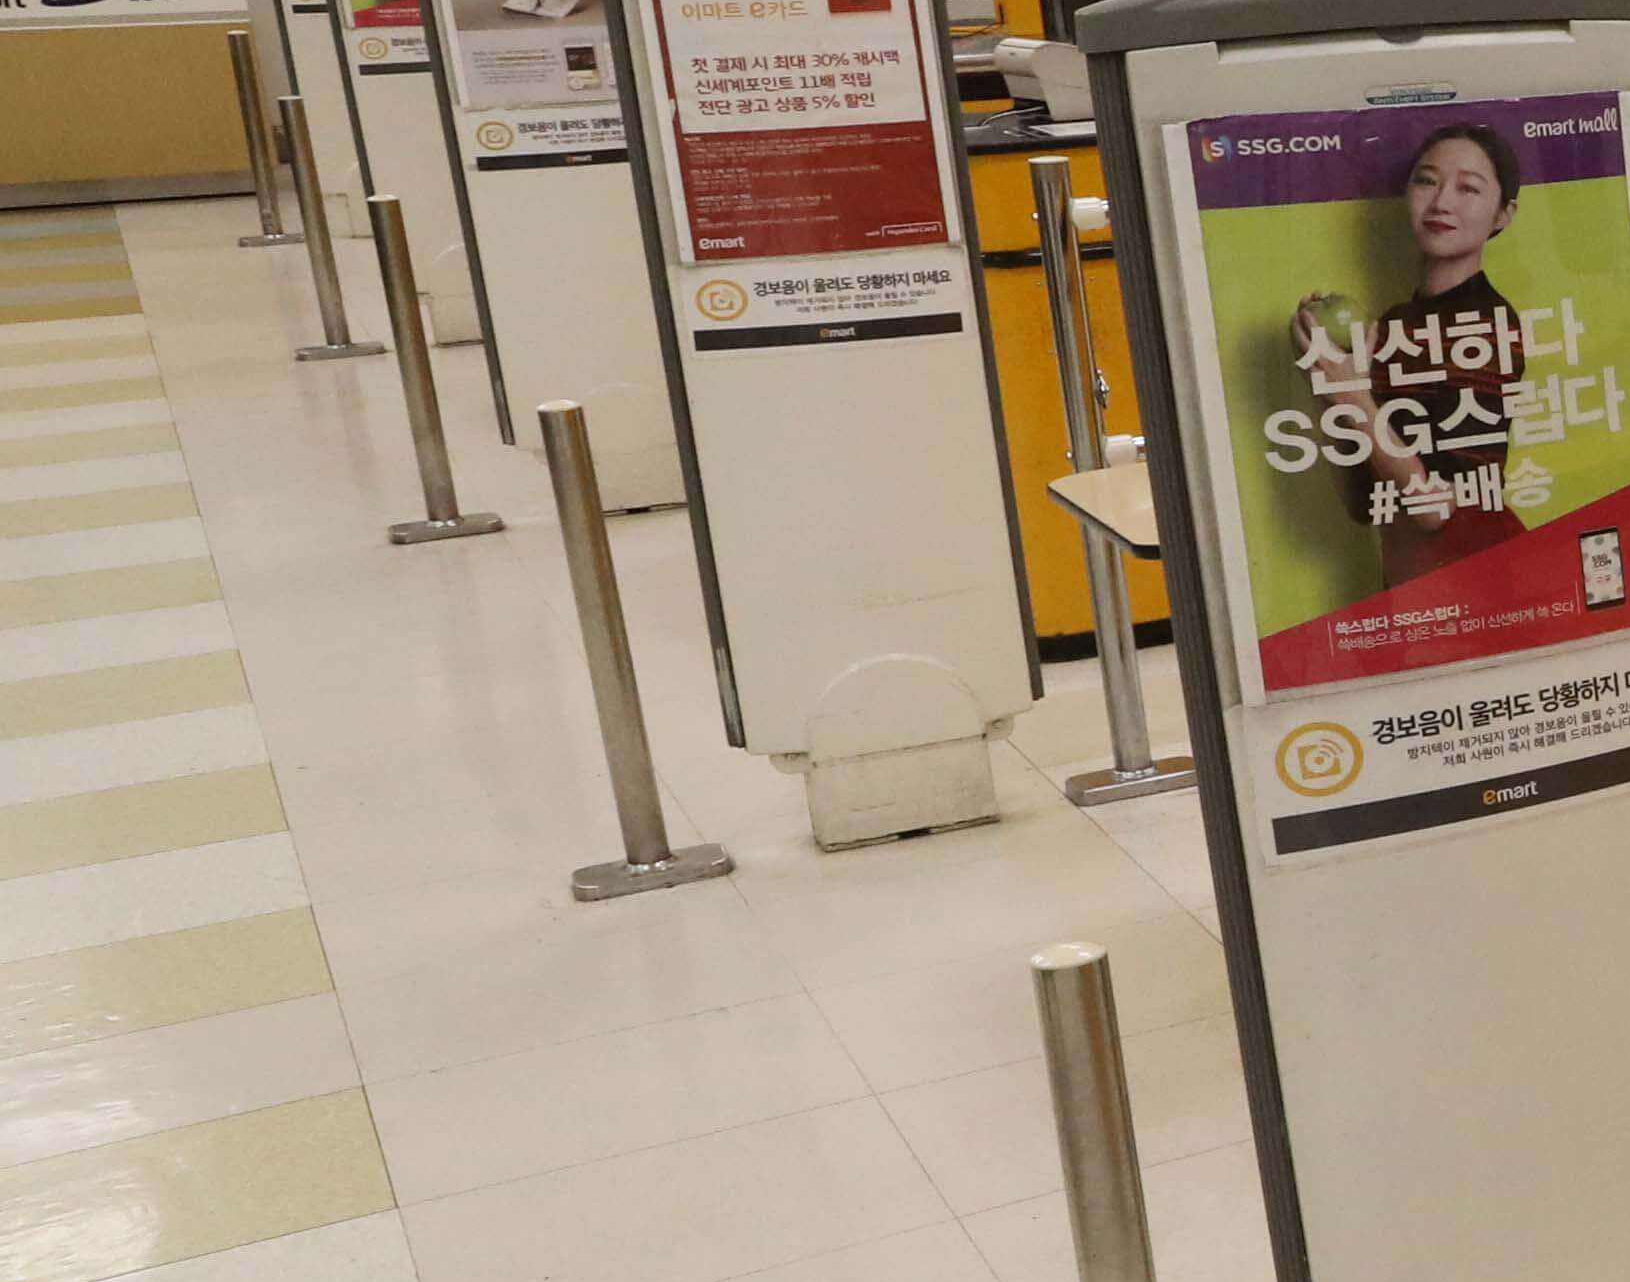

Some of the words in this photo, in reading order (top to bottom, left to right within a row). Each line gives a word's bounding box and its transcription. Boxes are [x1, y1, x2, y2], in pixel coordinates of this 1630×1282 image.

[682, 1, 744, 20] 이마트
[691, 56, 709, 75] 첫
[713, 55, 748, 74] 결제
[752, 54, 769, 72] 시
[774, 53, 807, 71] 최대
[812, 51, 851, 68] 30%
[853, 48, 901, 66] 캐시백
[695, 75, 795, 94] 신세계포인트
[799, 73, 836, 90] 11배
[840, 71, 873, 88] 적립
[698, 98, 732, 116] 전단
[736, 97, 772, 116] 광고
[776, 95, 808, 112] 상품
[812, 93, 841, 111] 5%
[845, 91, 877, 109] 할인
[1524, 118, 1575, 140] emart
[1579, 106, 1619, 135] mall
[1237, 134, 1341, 157] SSG.COM
[698, 235, 746, 252] emart
[753, 277, 810, 298] 경보음이
[813, 275, 855, 295] 울려도
[856, 271, 910, 291] 당황하지
[912, 269, 953, 286] 마세요
[1295, 297, 1584, 397] 신선하다
[1263, 364, 1626, 473] SSG스럽다
[1368, 454, 1553, 527] #쓱배송
[1335, 613, 1389, 636] 쓱스럽다
[1393, 603, 1460, 628] SSG스럽다
[1460, 616, 1485, 633] 없이
[1487, 608, 1535, 629] 신선하게
[1371, 703, 1463, 745] 경보음이
[1469, 690, 1535, 722] 울려도
[1539, 671, 1621, 713] 당황하지
[1458, 731, 1505, 753] 제거되지
[1534, 715, 1580, 742] 경보음이
[1442, 753, 1466, 767] 저희
[1470, 746, 1505, 763] 사원이
[1509, 739, 1532, 754] 즉시
[1534, 733, 1568, 749] 해결해
[1483, 780, 1538, 808] emart
